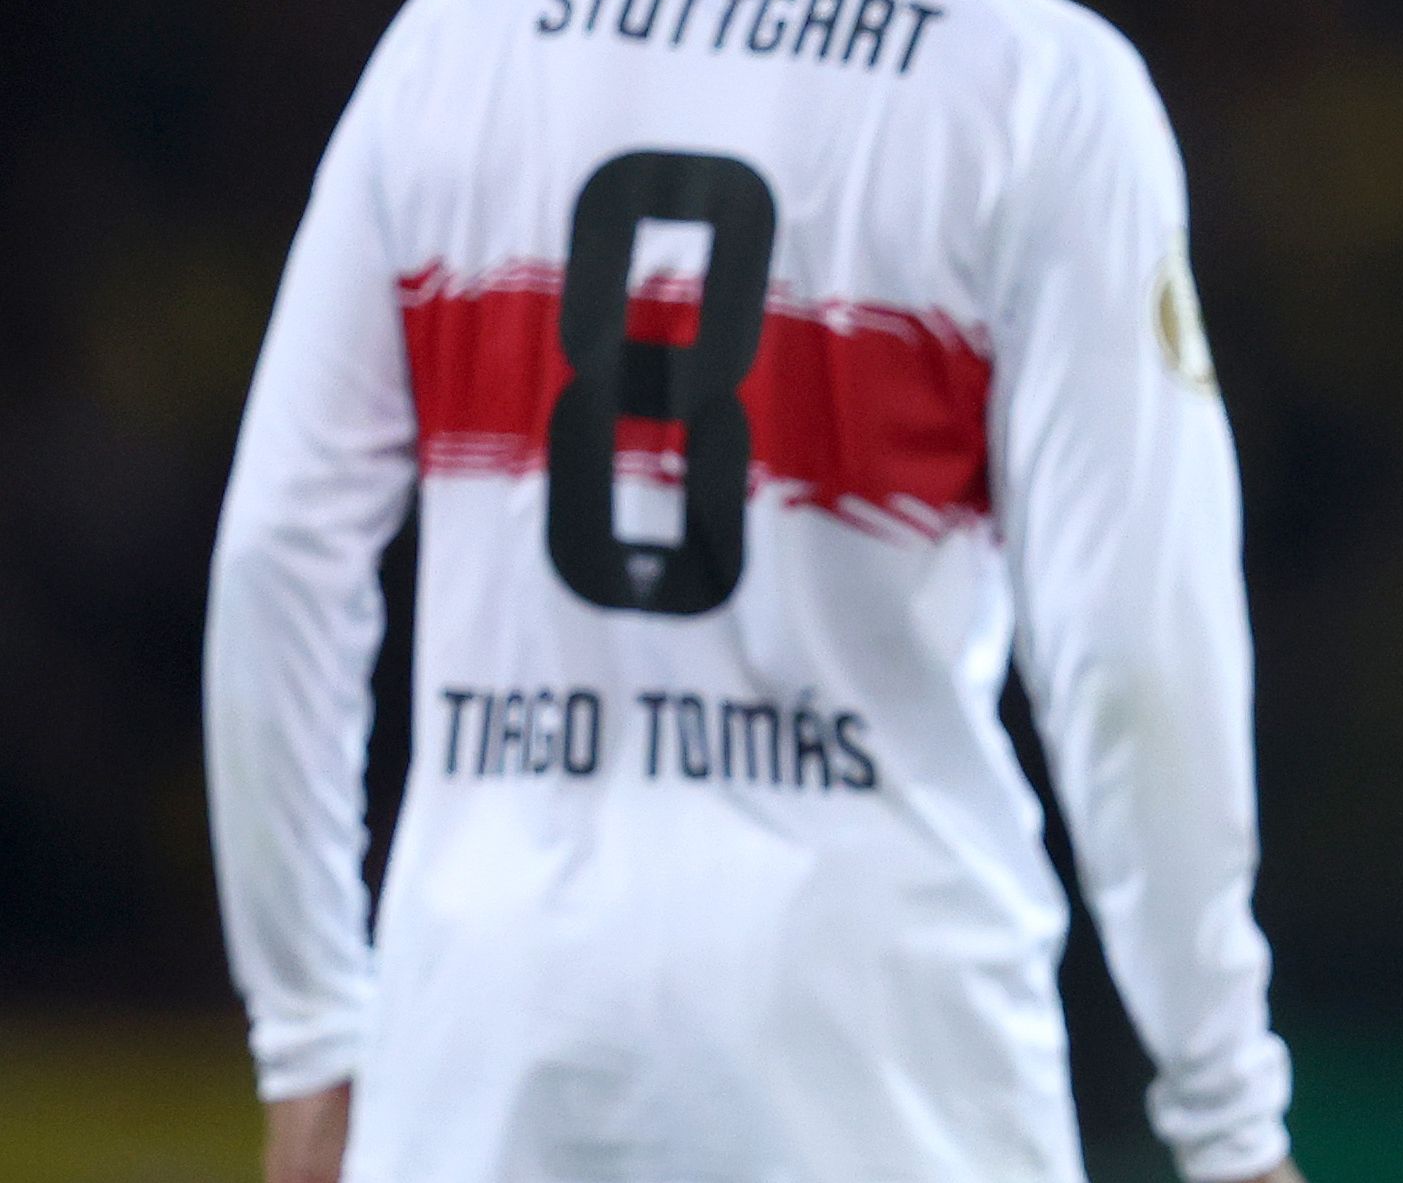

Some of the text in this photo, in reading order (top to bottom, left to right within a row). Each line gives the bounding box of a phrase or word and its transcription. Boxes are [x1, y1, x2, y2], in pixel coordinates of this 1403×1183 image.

[545, 149, 777, 614] 8
[442, 686, 878, 792] TIAGO TOMÁS
